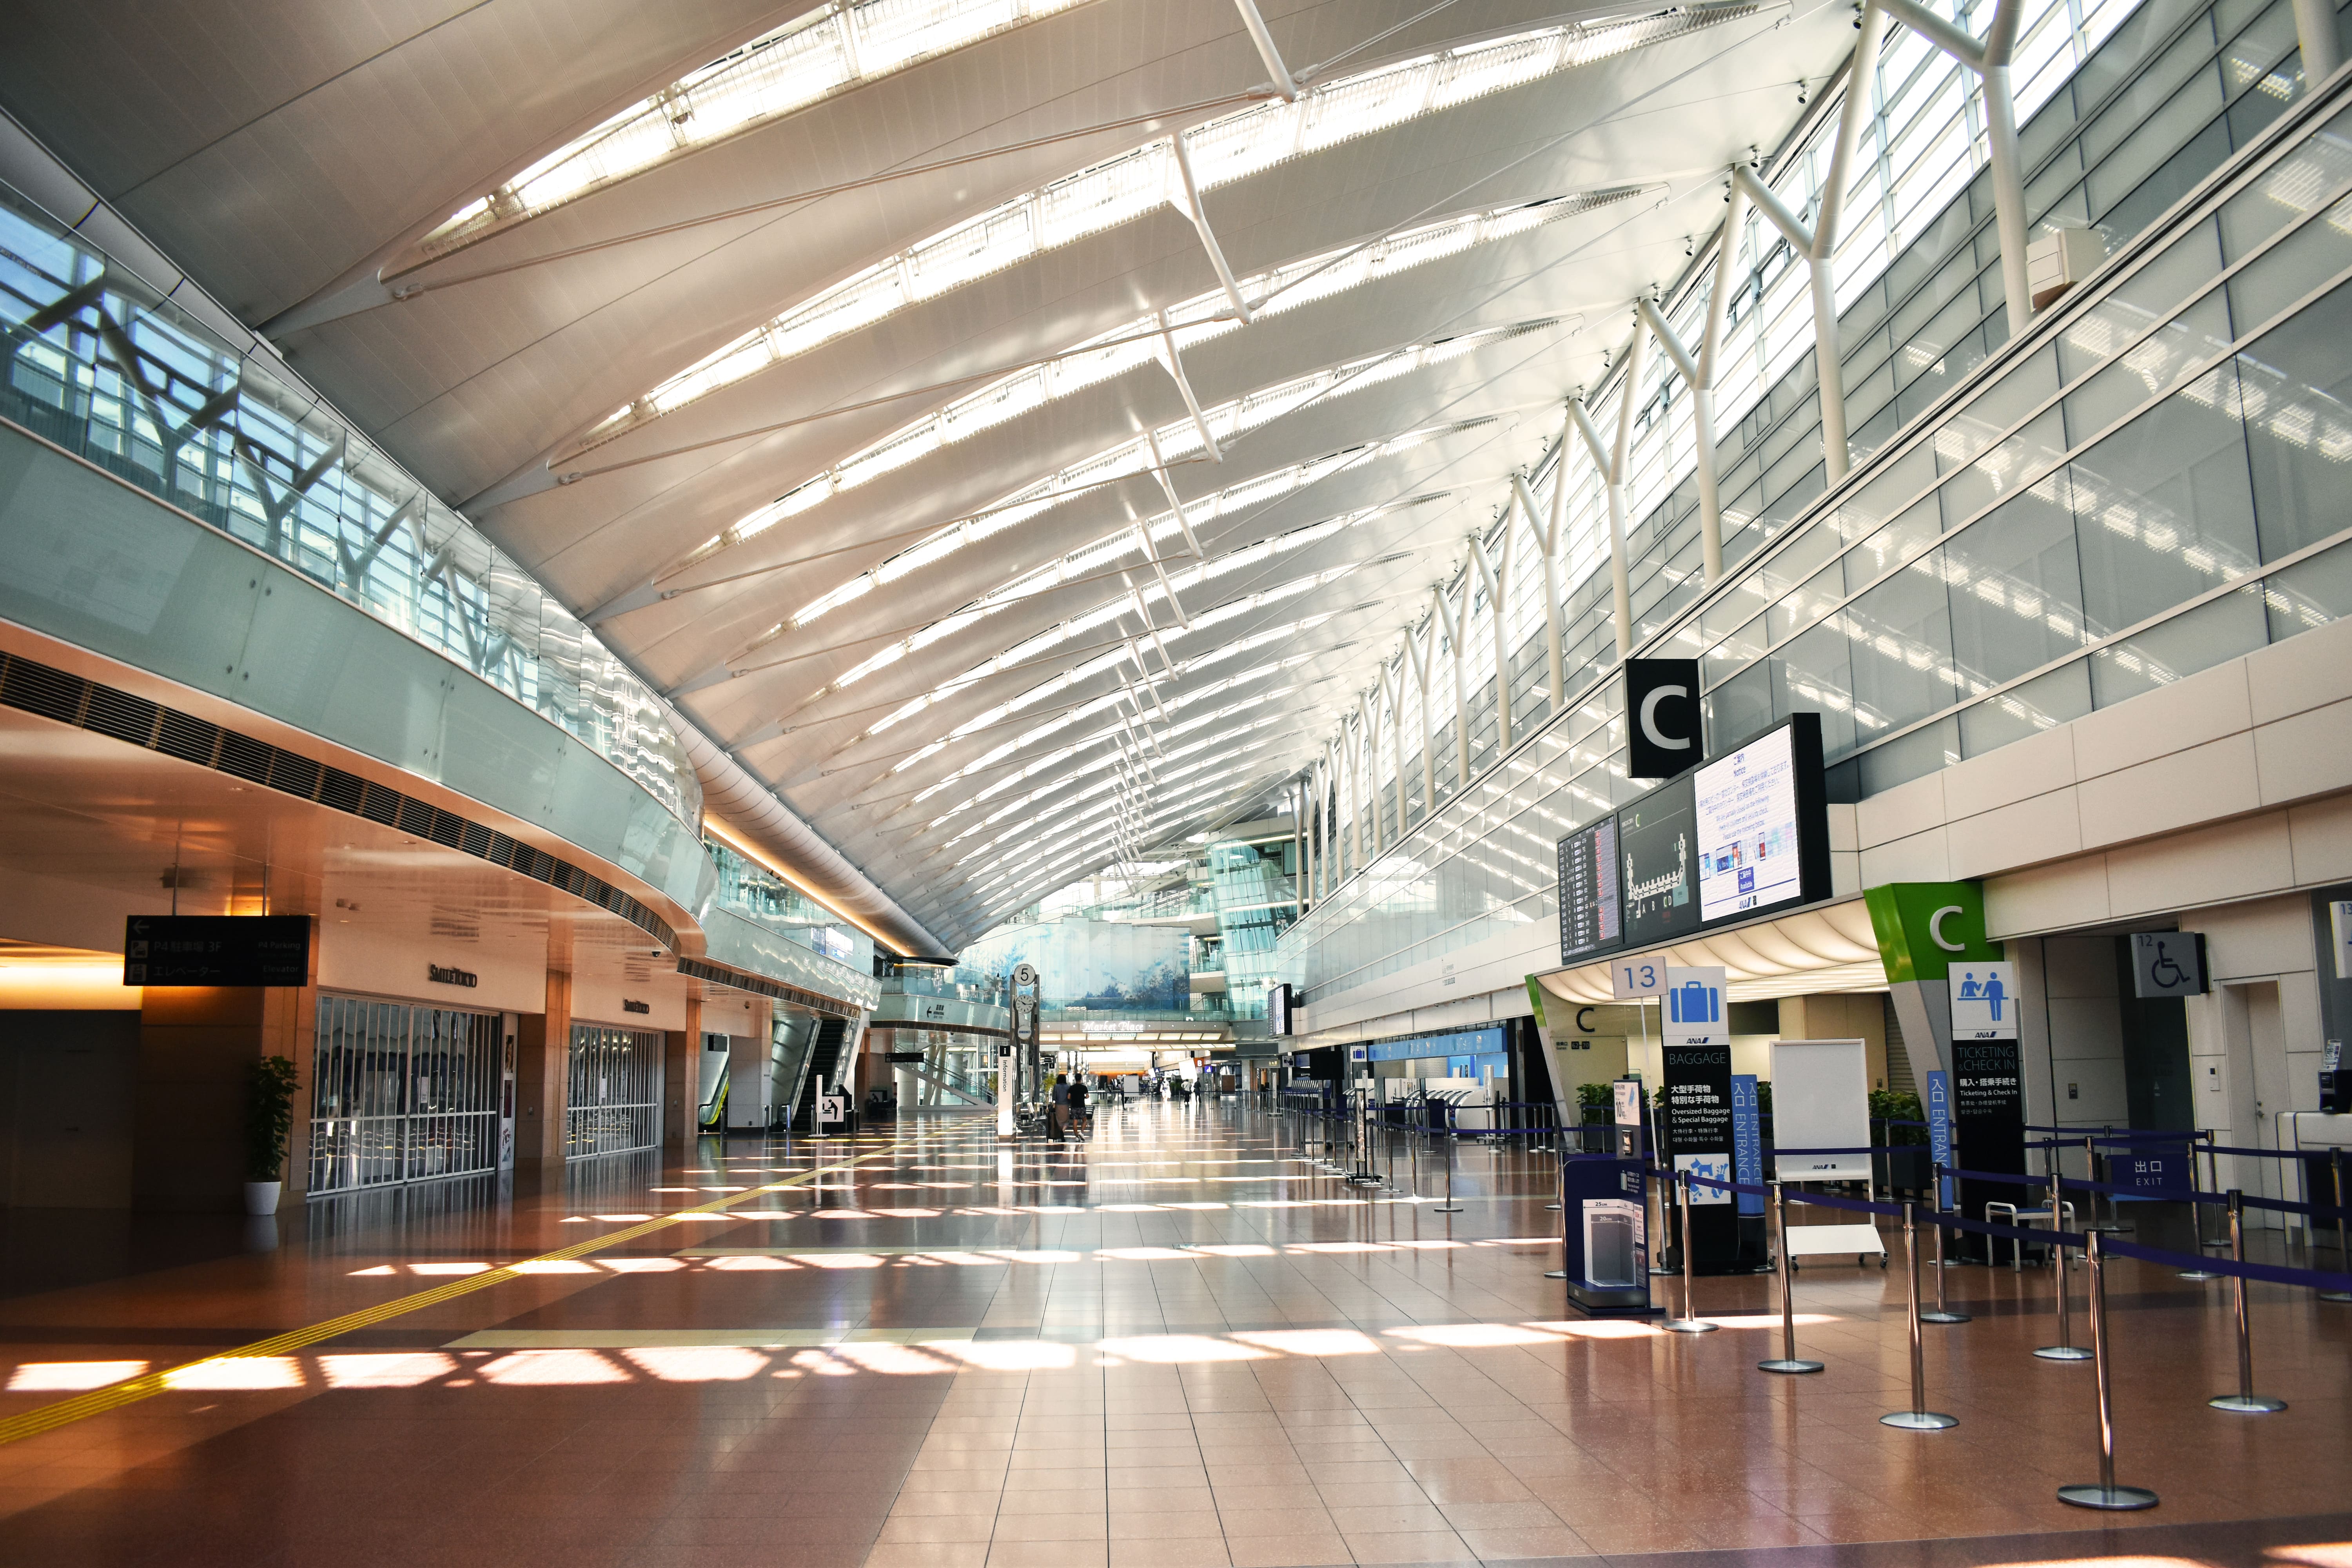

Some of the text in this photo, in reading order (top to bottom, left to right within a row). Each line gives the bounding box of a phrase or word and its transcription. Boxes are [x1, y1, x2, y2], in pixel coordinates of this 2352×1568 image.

[1640, 684, 1690, 750] C
[1734, 766, 1746, 777] Notice
[1635, 814, 1640, 827] C
[1642, 896, 1671, 913] A B C D
[1929, 905, 1965, 951] C
[270, 942, 301, 951] Parking
[2139, 935, 2153, 946] 12
[208, 941, 222, 953] 3F
[154, 966, 221, 976] エレベーター
[1020, 968, 1029, 981] 5
[1624, 965, 1655, 989] 13
[1082, 1020, 1144, 1031] Market Place
[1576, 1007, 1595, 1032] C
[1957, 1046, 2014, 1058] TICKETING
[1669, 1053, 1726, 1065] BAGGAGE
[2004, 1059, 2015, 1070] IN
[1960, 1078, 2017, 1087] 購入・搭乗手続き
[1671, 1085, 1711, 1094] 大型手荷物
[1932, 1079, 1944, 1102] 入口
[1671, 1095, 1719, 1105] 特別な手荷物
[1734, 1083, 1749, 1184] 入口 ENTRANCE
[1749, 1083, 1761, 1184] 入口 ENTRANCE
[2135, 1160, 2161, 1173] 出口
